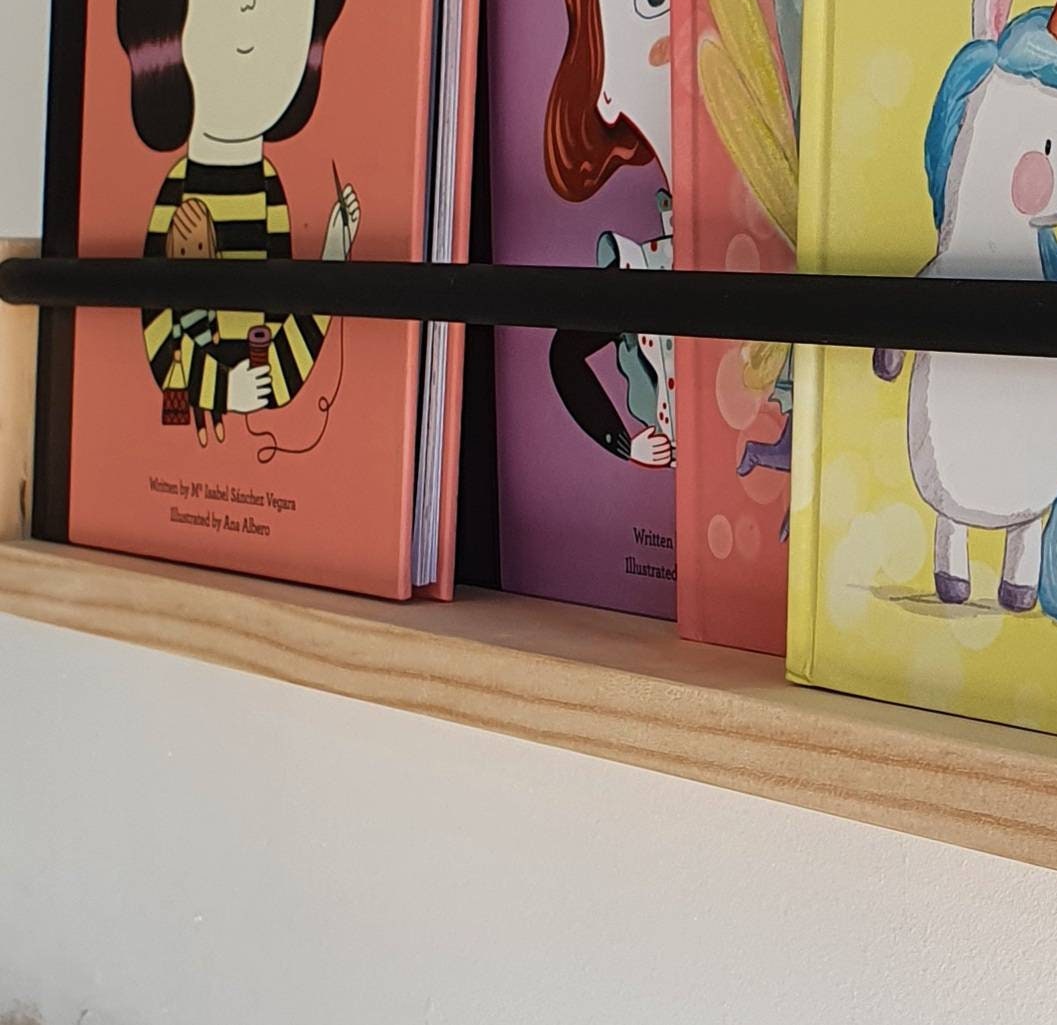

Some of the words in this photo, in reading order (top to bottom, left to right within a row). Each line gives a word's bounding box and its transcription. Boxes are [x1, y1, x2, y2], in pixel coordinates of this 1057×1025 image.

[149, 476, 178, 495] Written
[180, 479, 190, 499] by
[204, 484, 229, 502] Isabel
[266, 492, 296, 512] Vegara
[170, 507, 210, 527] Illustrated
[211, 512, 222, 532] by
[223, 515, 240, 532] Ana
[241, 517, 270, 536] Albero
[632, 527, 674, 550] Written
[625, 556, 678, 582] Illustrated
